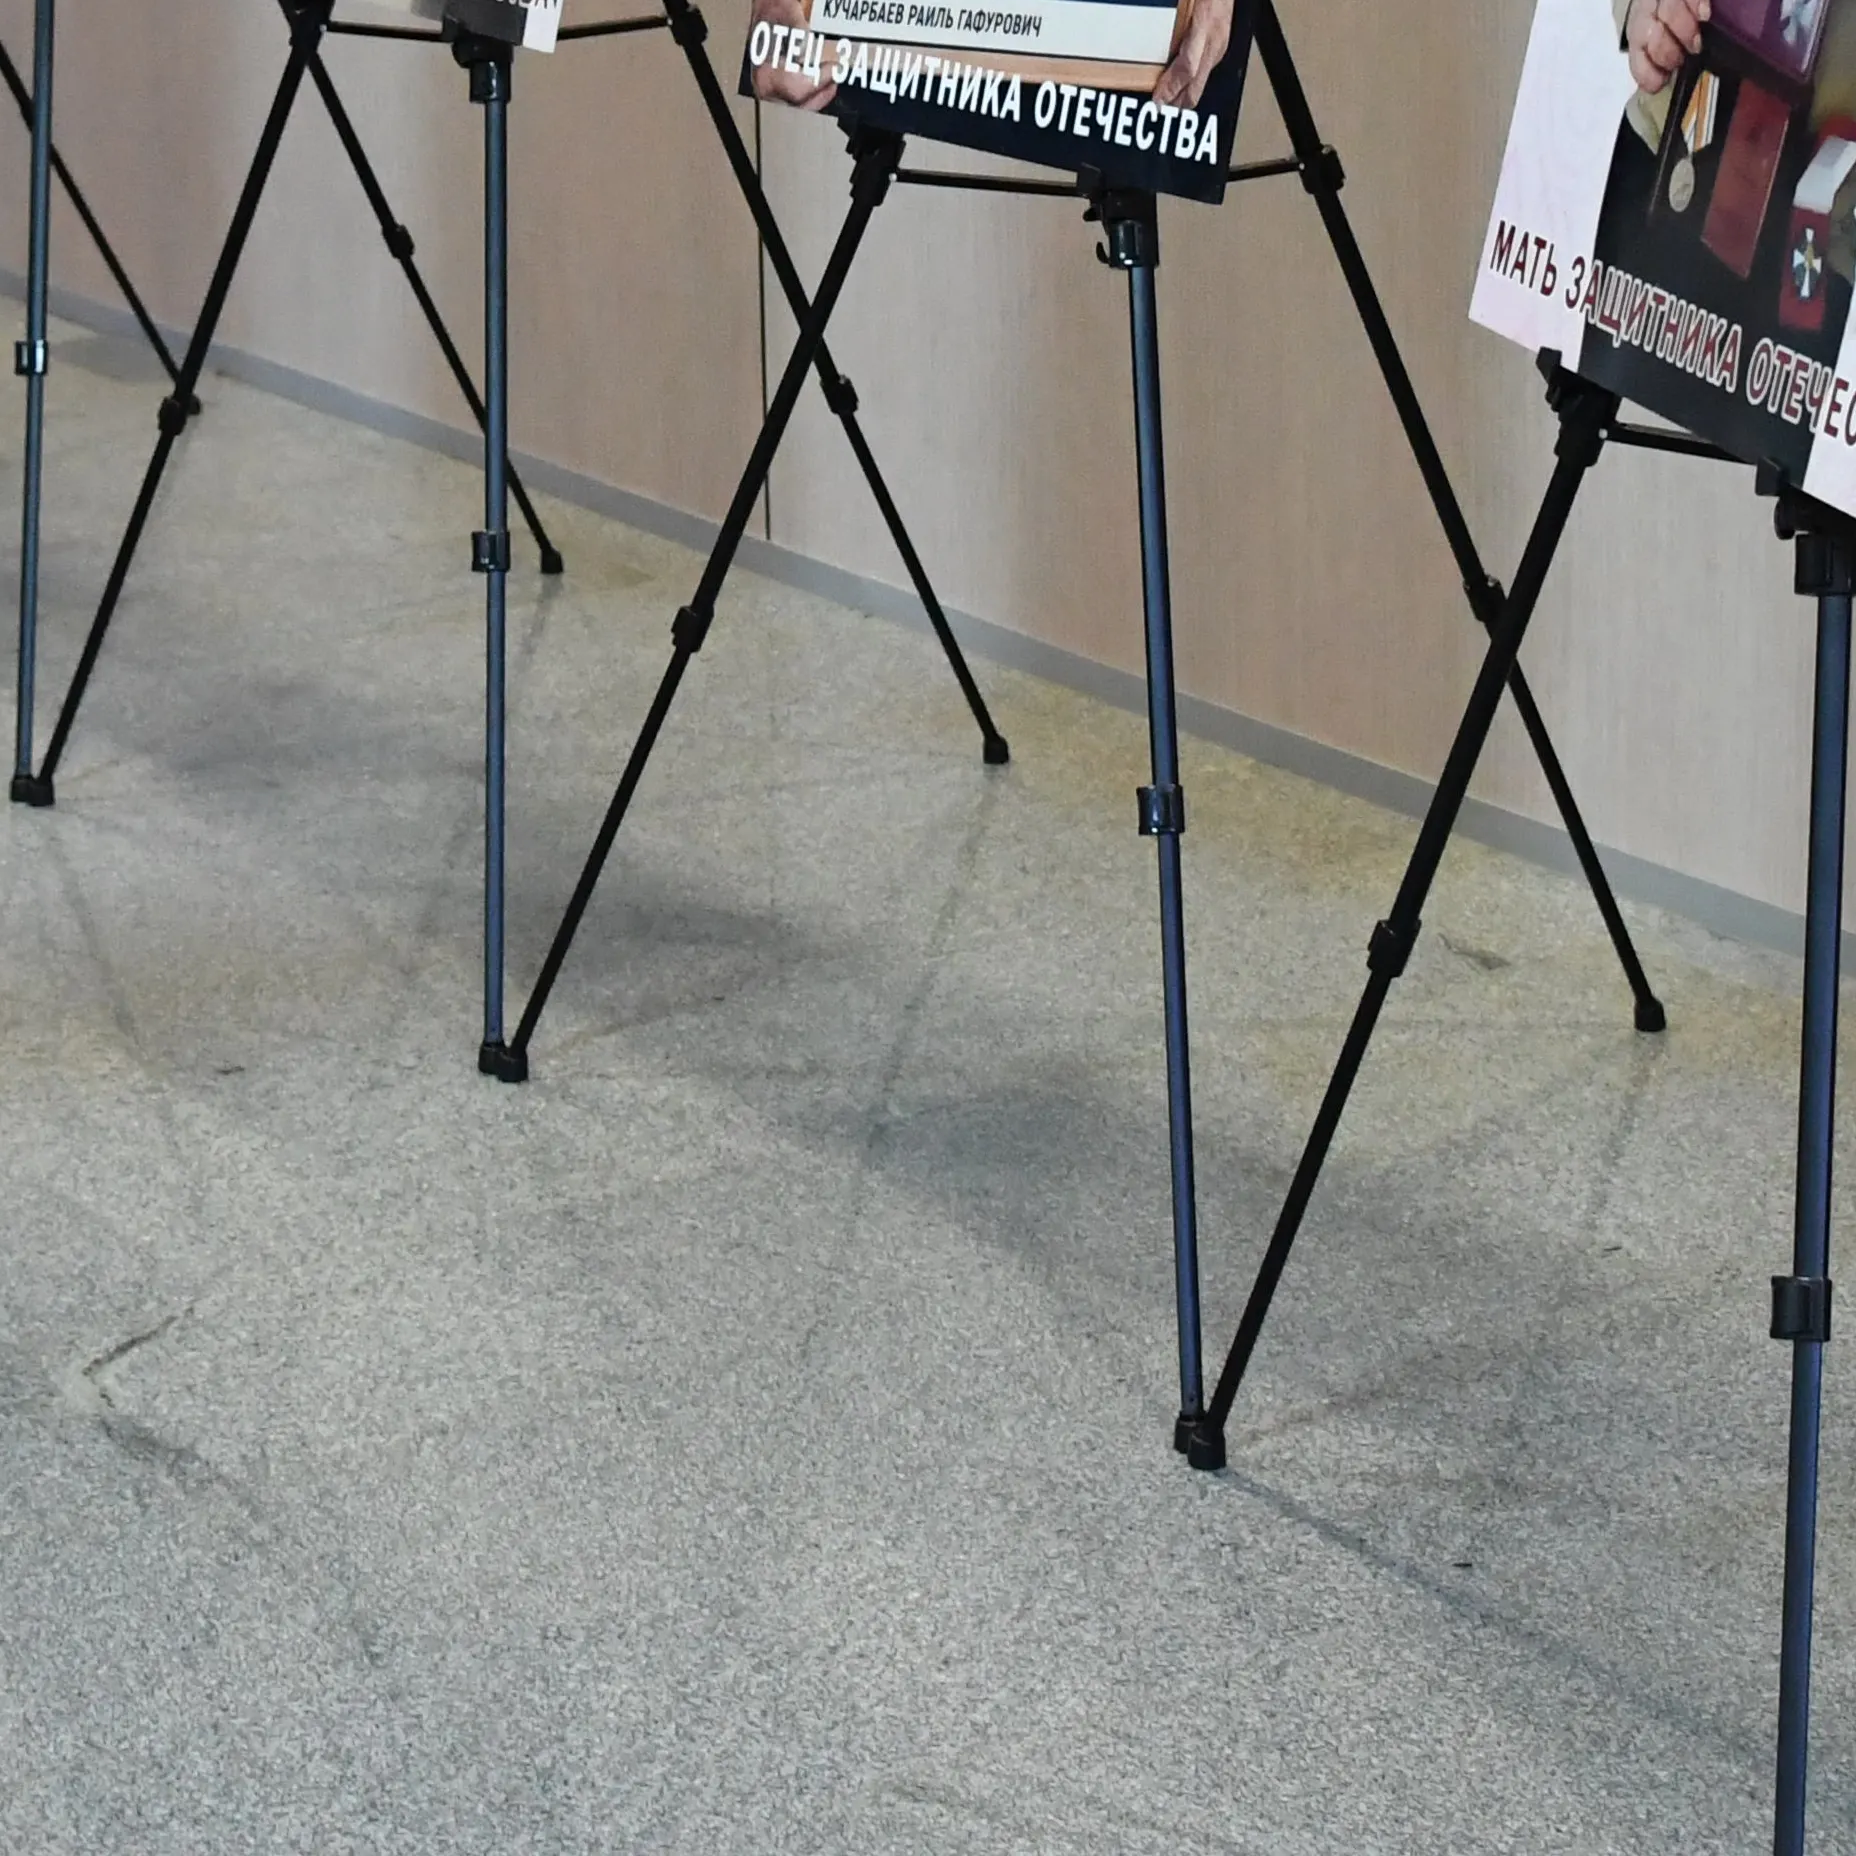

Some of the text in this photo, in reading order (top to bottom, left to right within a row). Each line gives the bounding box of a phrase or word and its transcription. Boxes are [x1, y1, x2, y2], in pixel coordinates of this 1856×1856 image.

[749, 21, 1220, 166] ОТЕЦ ЗАЩИТНИКА ОТЕЧЕСТВА
[907, 4, 954, 29] РАИЛЬ
[956, 9, 1043, 38] ГАФУРОВИЧ
[1489, 220, 1558, 298] МАТЬ
[1565, 256, 1743, 394] ЗАЩИТНИКА
